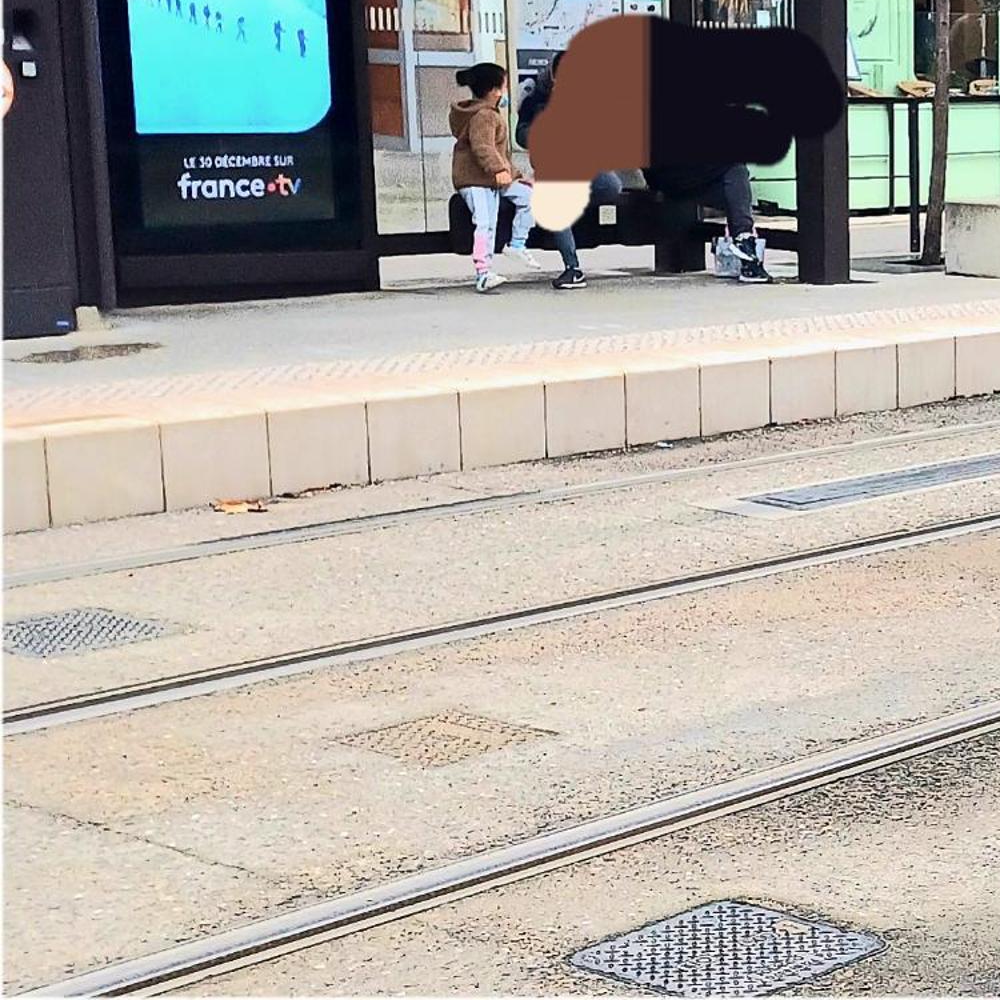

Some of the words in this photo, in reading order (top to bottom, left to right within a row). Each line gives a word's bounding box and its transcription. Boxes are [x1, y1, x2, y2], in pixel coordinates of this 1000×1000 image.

[183, 156, 197, 169] LE
[214, 153, 272, 168] DÉCEMBRE
[273, 154, 295, 166] SUR
